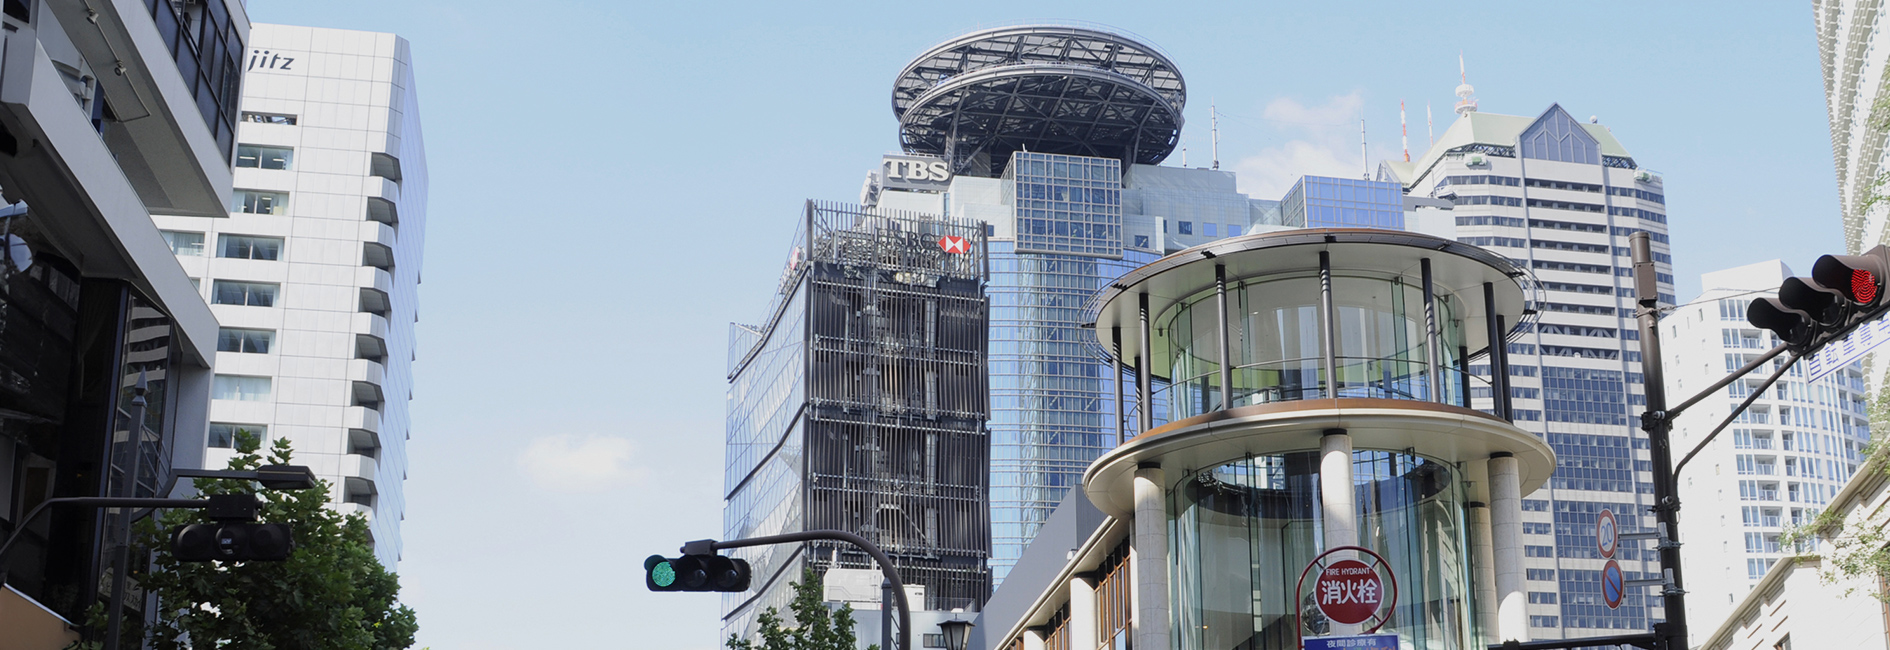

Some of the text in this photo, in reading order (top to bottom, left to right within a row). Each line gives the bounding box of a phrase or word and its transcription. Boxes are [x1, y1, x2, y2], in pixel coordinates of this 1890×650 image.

[883, 158, 950, 182] TBS
[1600, 522, 1613, 547] 20
[1326, 567, 1370, 576] FIRE HYDRANT
[1321, 578, 1378, 605] 消火栓
[1326, 638, 1377, 648] 夜間診療有
